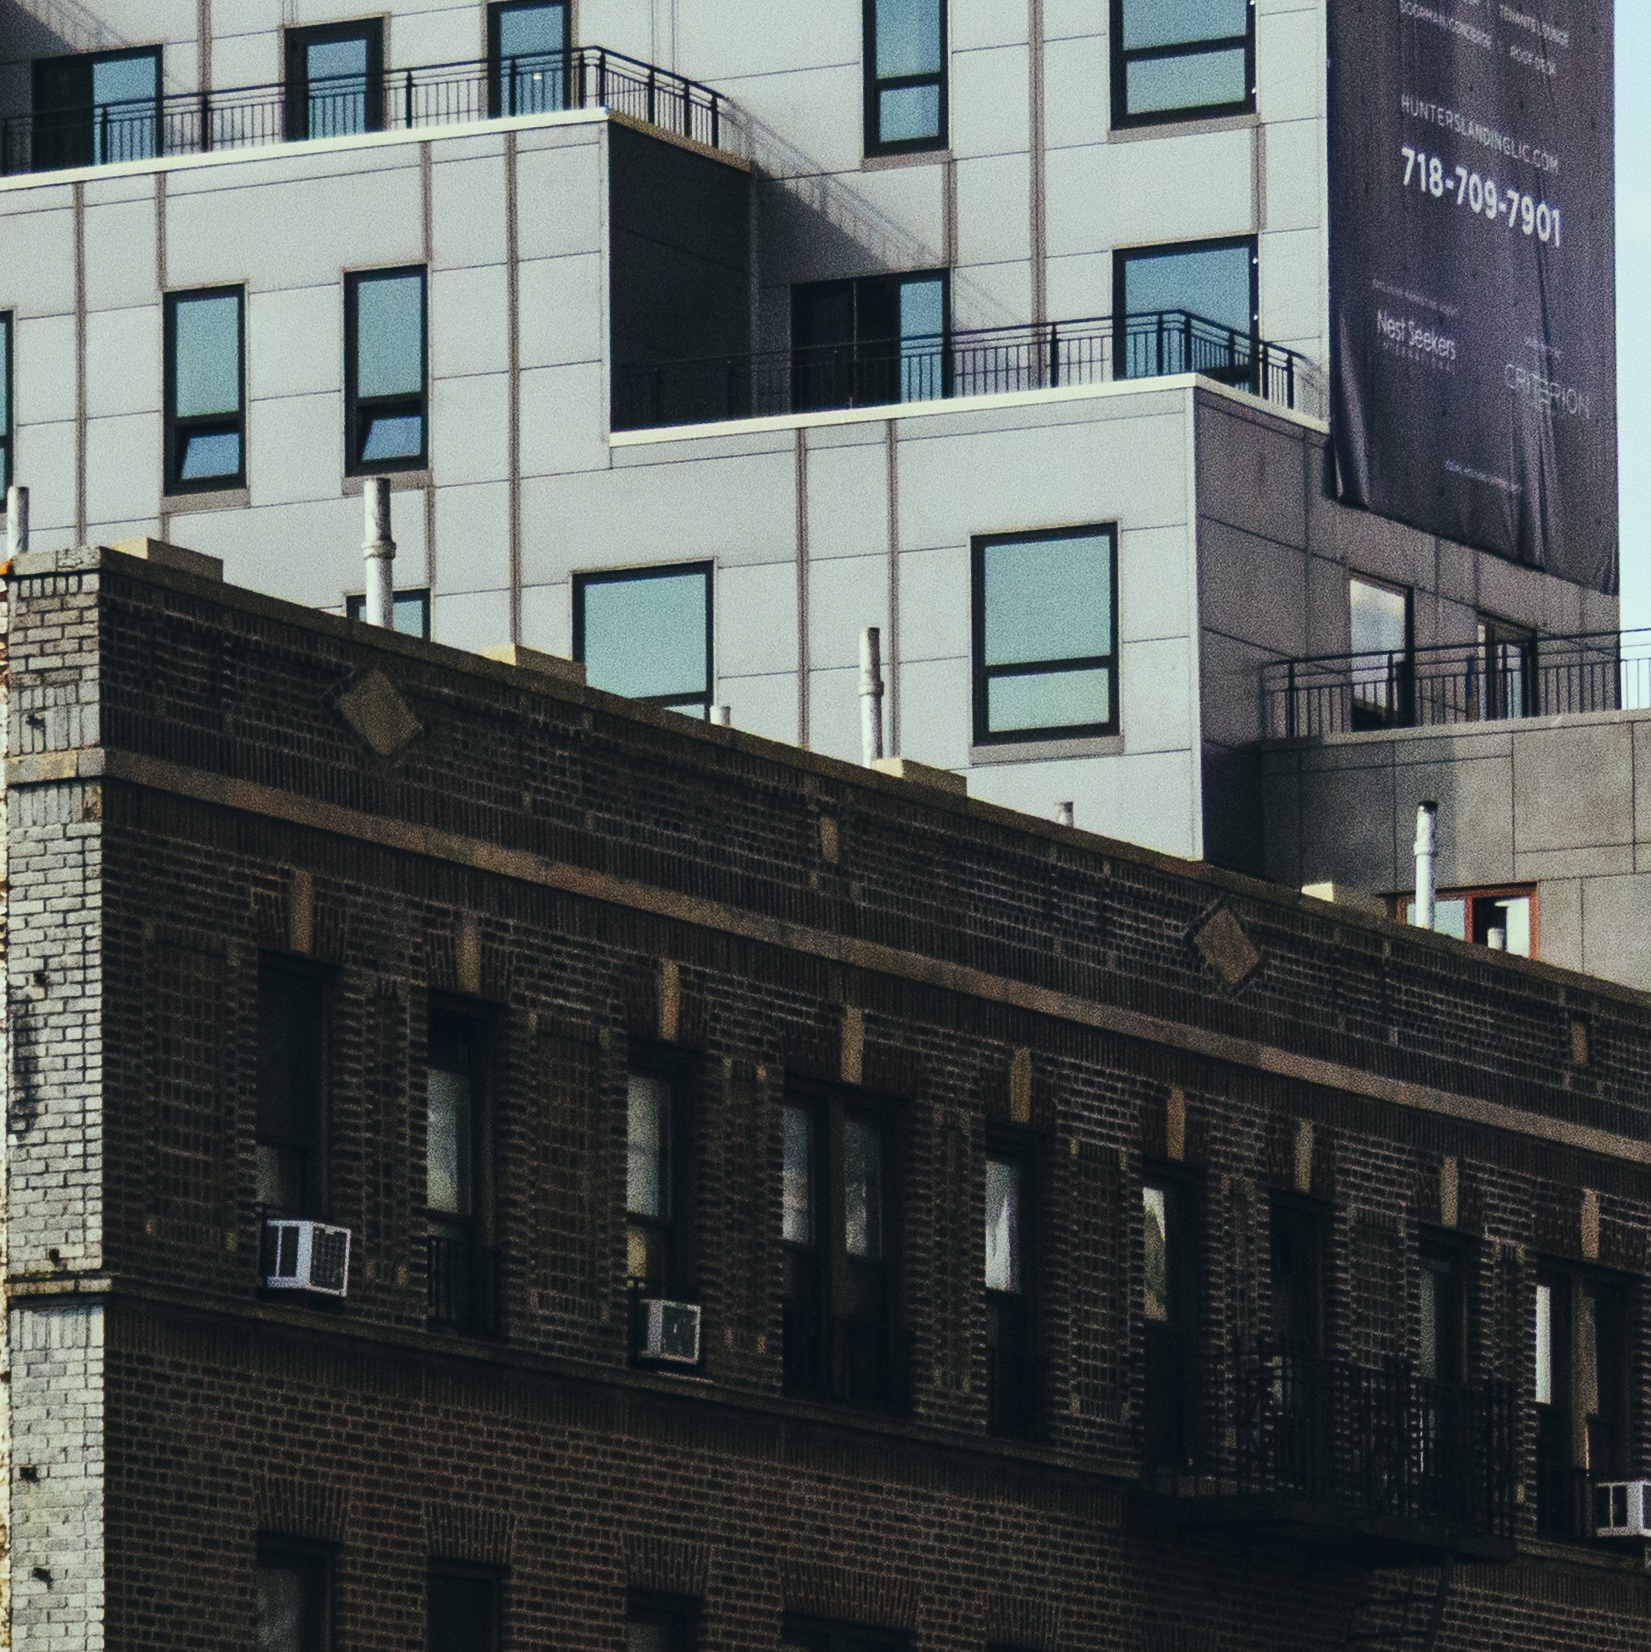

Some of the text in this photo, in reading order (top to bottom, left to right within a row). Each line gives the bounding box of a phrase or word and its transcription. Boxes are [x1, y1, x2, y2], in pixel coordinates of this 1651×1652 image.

[1401, 147, 1560, 247] 718-709-7901
[1377, 309, 1406, 341] Nest
[1408, 319, 1456, 361] Seekers
[1504, 363, 1591, 420] CRITERION
